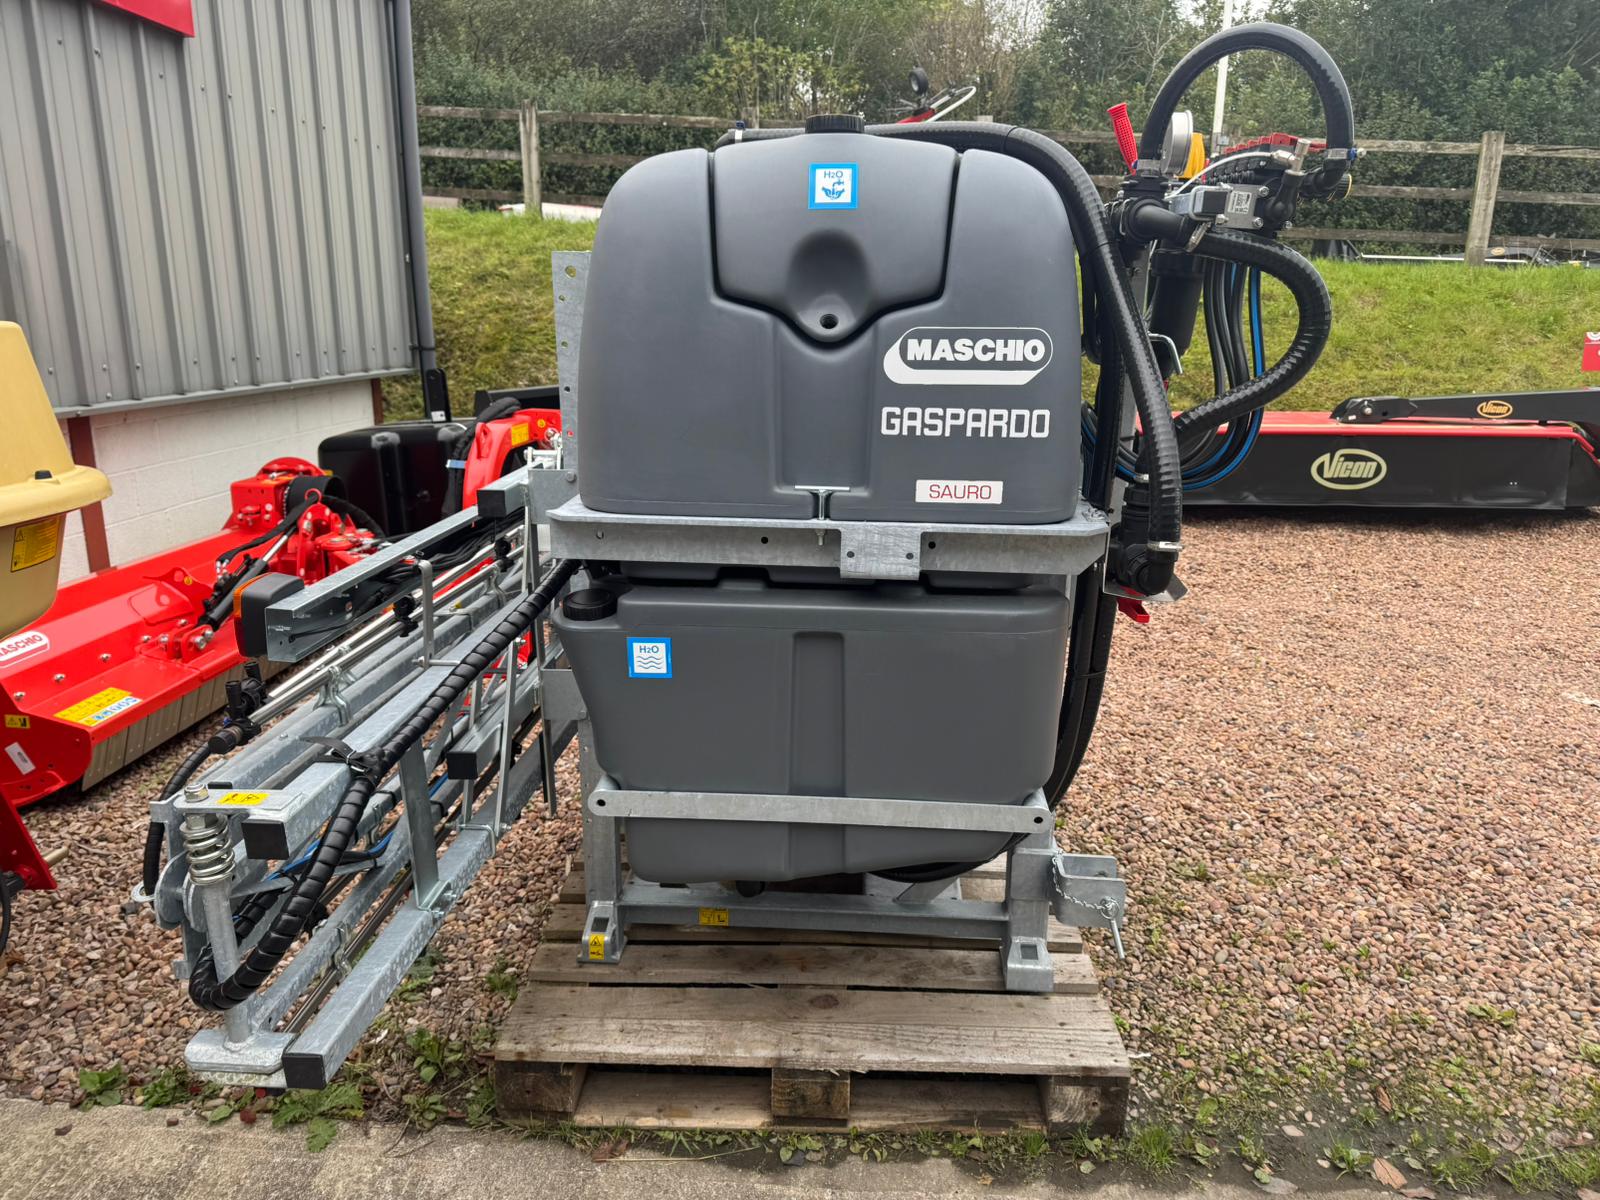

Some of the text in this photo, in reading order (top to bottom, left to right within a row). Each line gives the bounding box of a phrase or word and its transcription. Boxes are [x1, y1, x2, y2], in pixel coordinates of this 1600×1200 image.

[907, 338, 1046, 362] MASCHIO
[1482, 400, 1509, 414] Vicon
[881, 406, 1050, 438] GASPARDO
[1323, 450, 1378, 478] Vicon
[929, 483, 992, 500] SAURO
[0, 634, 43, 656] ASCHIO
[639, 645, 660, 654] H2O
